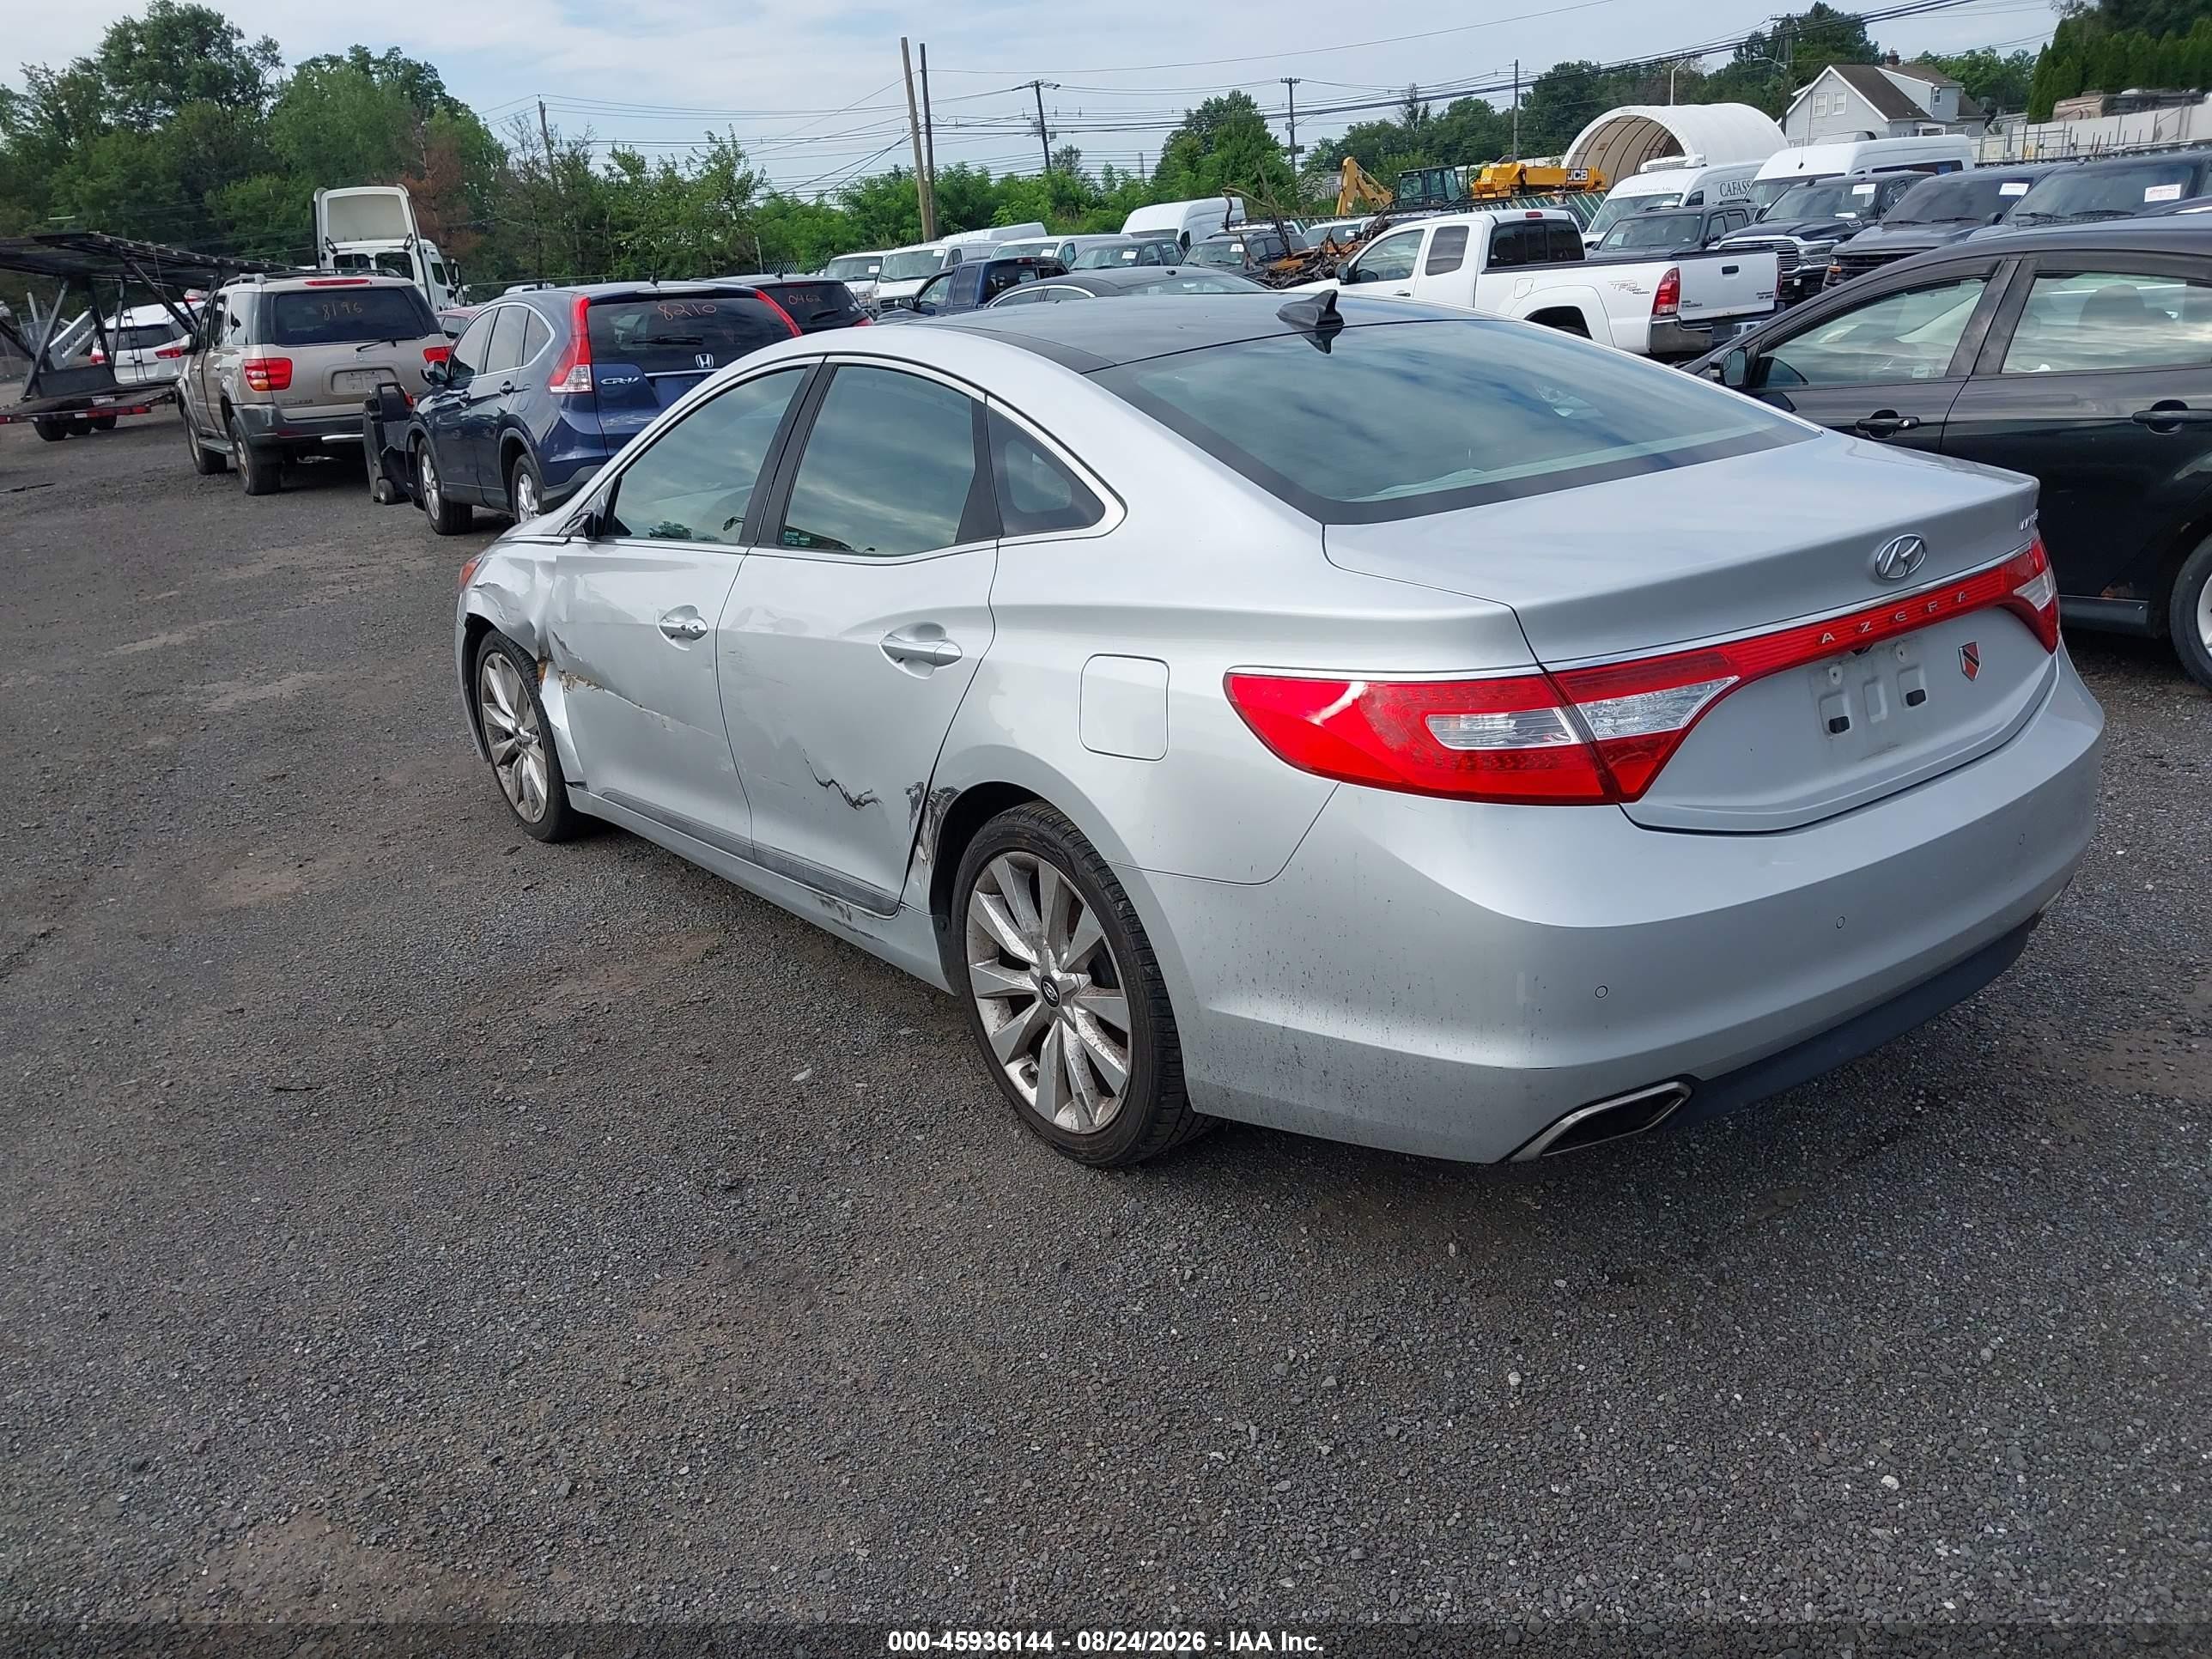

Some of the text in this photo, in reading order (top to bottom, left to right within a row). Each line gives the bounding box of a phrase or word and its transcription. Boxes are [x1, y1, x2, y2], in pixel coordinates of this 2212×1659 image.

[1567, 169, 1589, 181] JCB
[322, 301, 363, 321] 8196
[658, 302, 717, 321] 8210
[600, 376, 640, 386] CR-V
